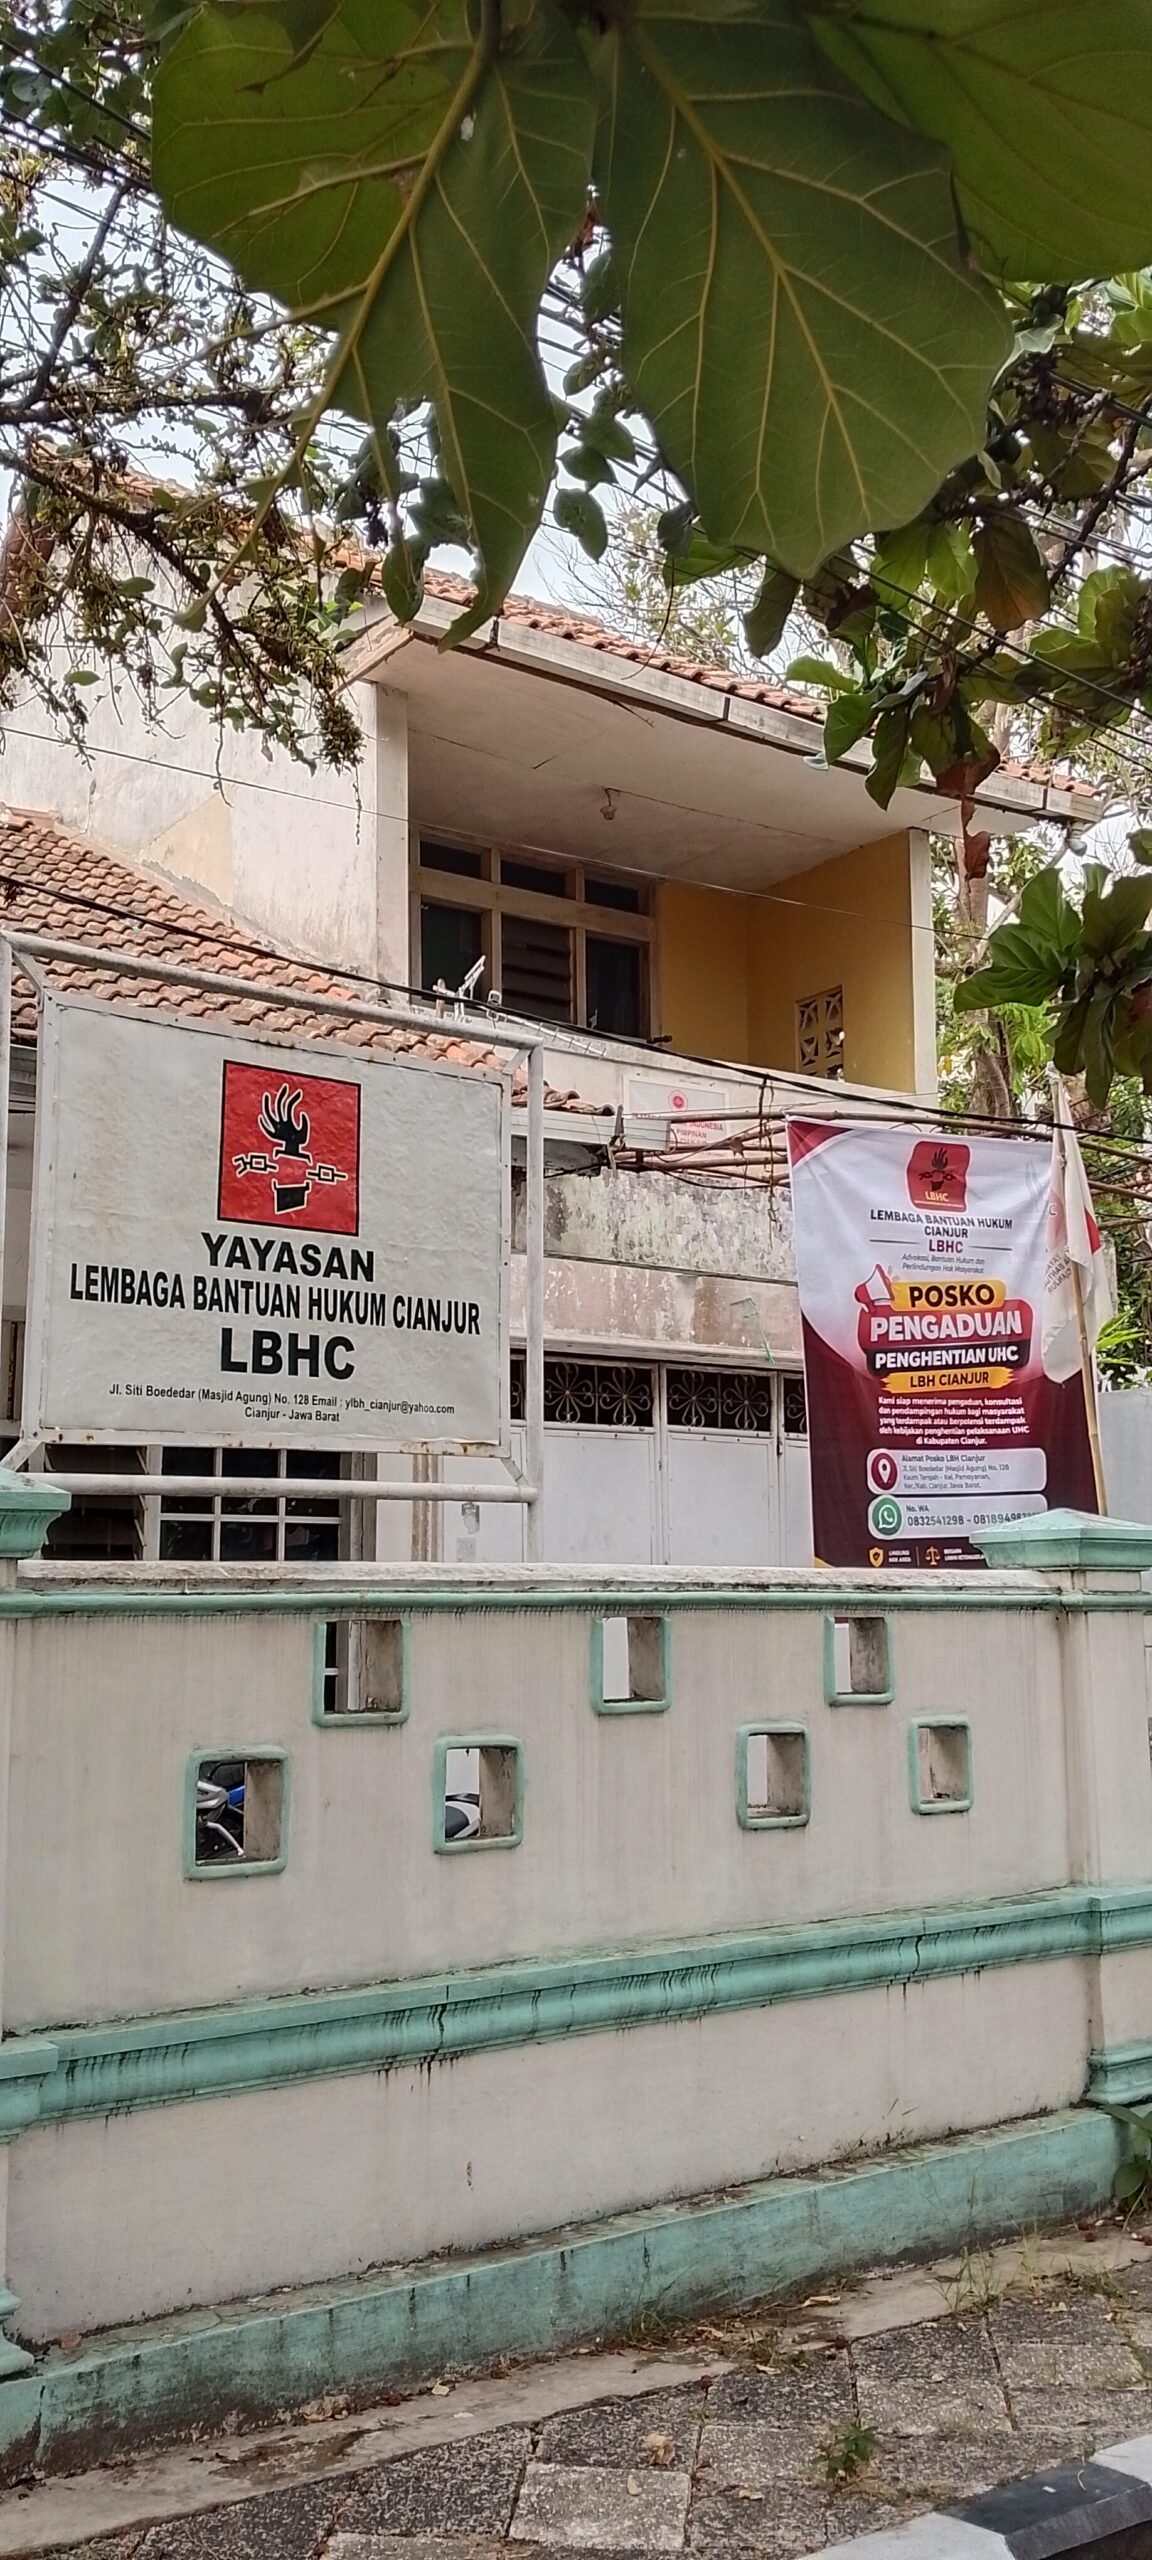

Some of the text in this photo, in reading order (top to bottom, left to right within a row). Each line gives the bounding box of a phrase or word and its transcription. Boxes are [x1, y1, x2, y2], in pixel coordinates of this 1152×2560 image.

[925, 1191, 949, 1202] LBHC
[870, 1209, 1013, 1229] LEMBAGA BANTUAN HUKUM
[924, 1226, 968, 1238] CIANJUR
[929, 1240, 964, 1253] LBHC
[201, 1232, 374, 1282] YAYASAN
[70, 1263, 481, 1335] LEMBAGA BANTUAN HUKUM CIANJUR
[909, 1283, 995, 1308] POSKO
[870, 1311, 1022, 1342] PENGADUAN
[220, 1328, 355, 1380] LBHC
[875, 1346, 1019, 1369] PENGHENTIAN UHC
[910, 1371, 989, 1388] LBH CIANJUR
[109, 1384, 122, 1395] Jl.
[125, 1384, 143, 1396] Siti
[146, 1385, 195, 1399] Boededar
[198, 1387, 233, 1403] (Masjid
[235, 1390, 271, 1406] Agung)
[274, 1392, 290, 1404] No.
[294, 1394, 309, 1405] 128
[312, 1395, 337, 1407] Email
[345, 1397, 455, 1414] ylbh_cianjur@yahoo.com
[879, 1396, 895, 1405] Kami
[896, 1396, 911, 1406] siap
[912, 1397, 947, 1405] menerima
[984, 1397, 1023, 1405] konsultasi
[245, 1407, 280, 1421] Cianjur
[288, 1409, 313, 1421] Jawa
[315, 1410, 340, 1422] Barat
[879, 1406, 1025, 1417] dan pendampingan hukum bagi masyarakat
[880, 1418, 895, 1426] yang
[895, 1417, 932, 1426] terdampak
[949, 1417, 984, 1426] berpotensi
[985, 1416, 1026, 1425] terdampak
[893, 1426, 923, 1436] kebijakan
[924, 1427, 965, 1436] penghentian
[966, 1427, 1011, 1436] pelaksanaan
[1012, 1425, 1030, 1434] UHC
[916, 1436, 987, 1446] di Kabupaten Cianjur.
[961, 1454, 985, 1463] Cianjur
[907, 1515, 964, 1526] 0832541298
